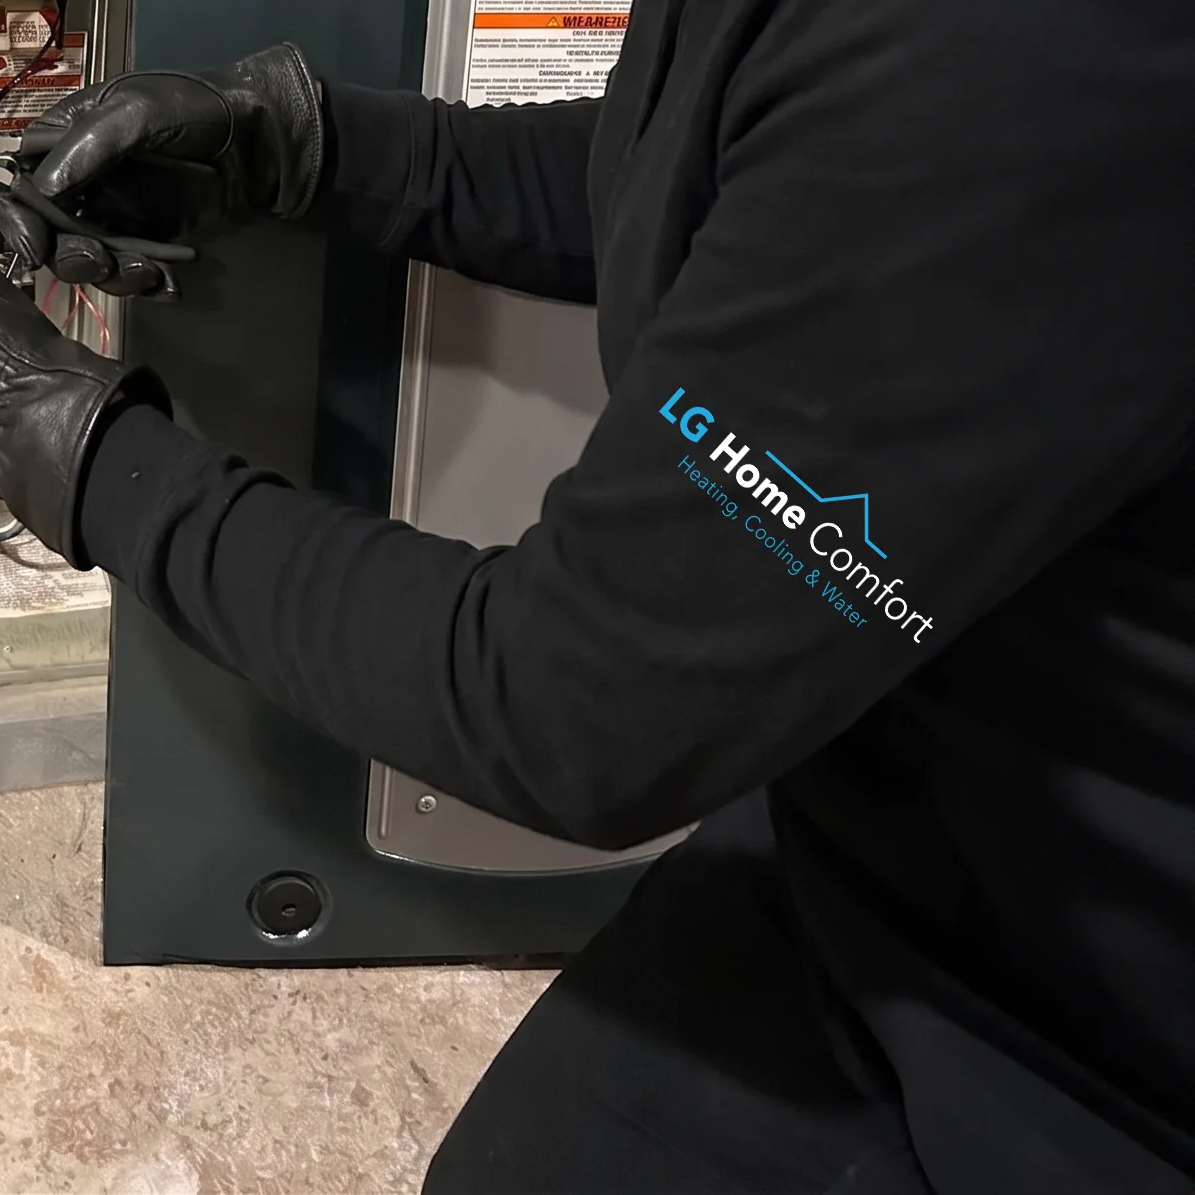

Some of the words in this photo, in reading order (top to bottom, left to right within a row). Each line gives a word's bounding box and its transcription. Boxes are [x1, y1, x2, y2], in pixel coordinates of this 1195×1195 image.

[658, 387, 715, 443] LG
[709, 432, 806, 530] Home
[809, 522, 934, 644] Comfort
[677, 455, 739, 520] Heating,
[745, 515, 804, 576] Cooling
[805, 569, 820, 587] &
[821, 581, 868, 628] Water
